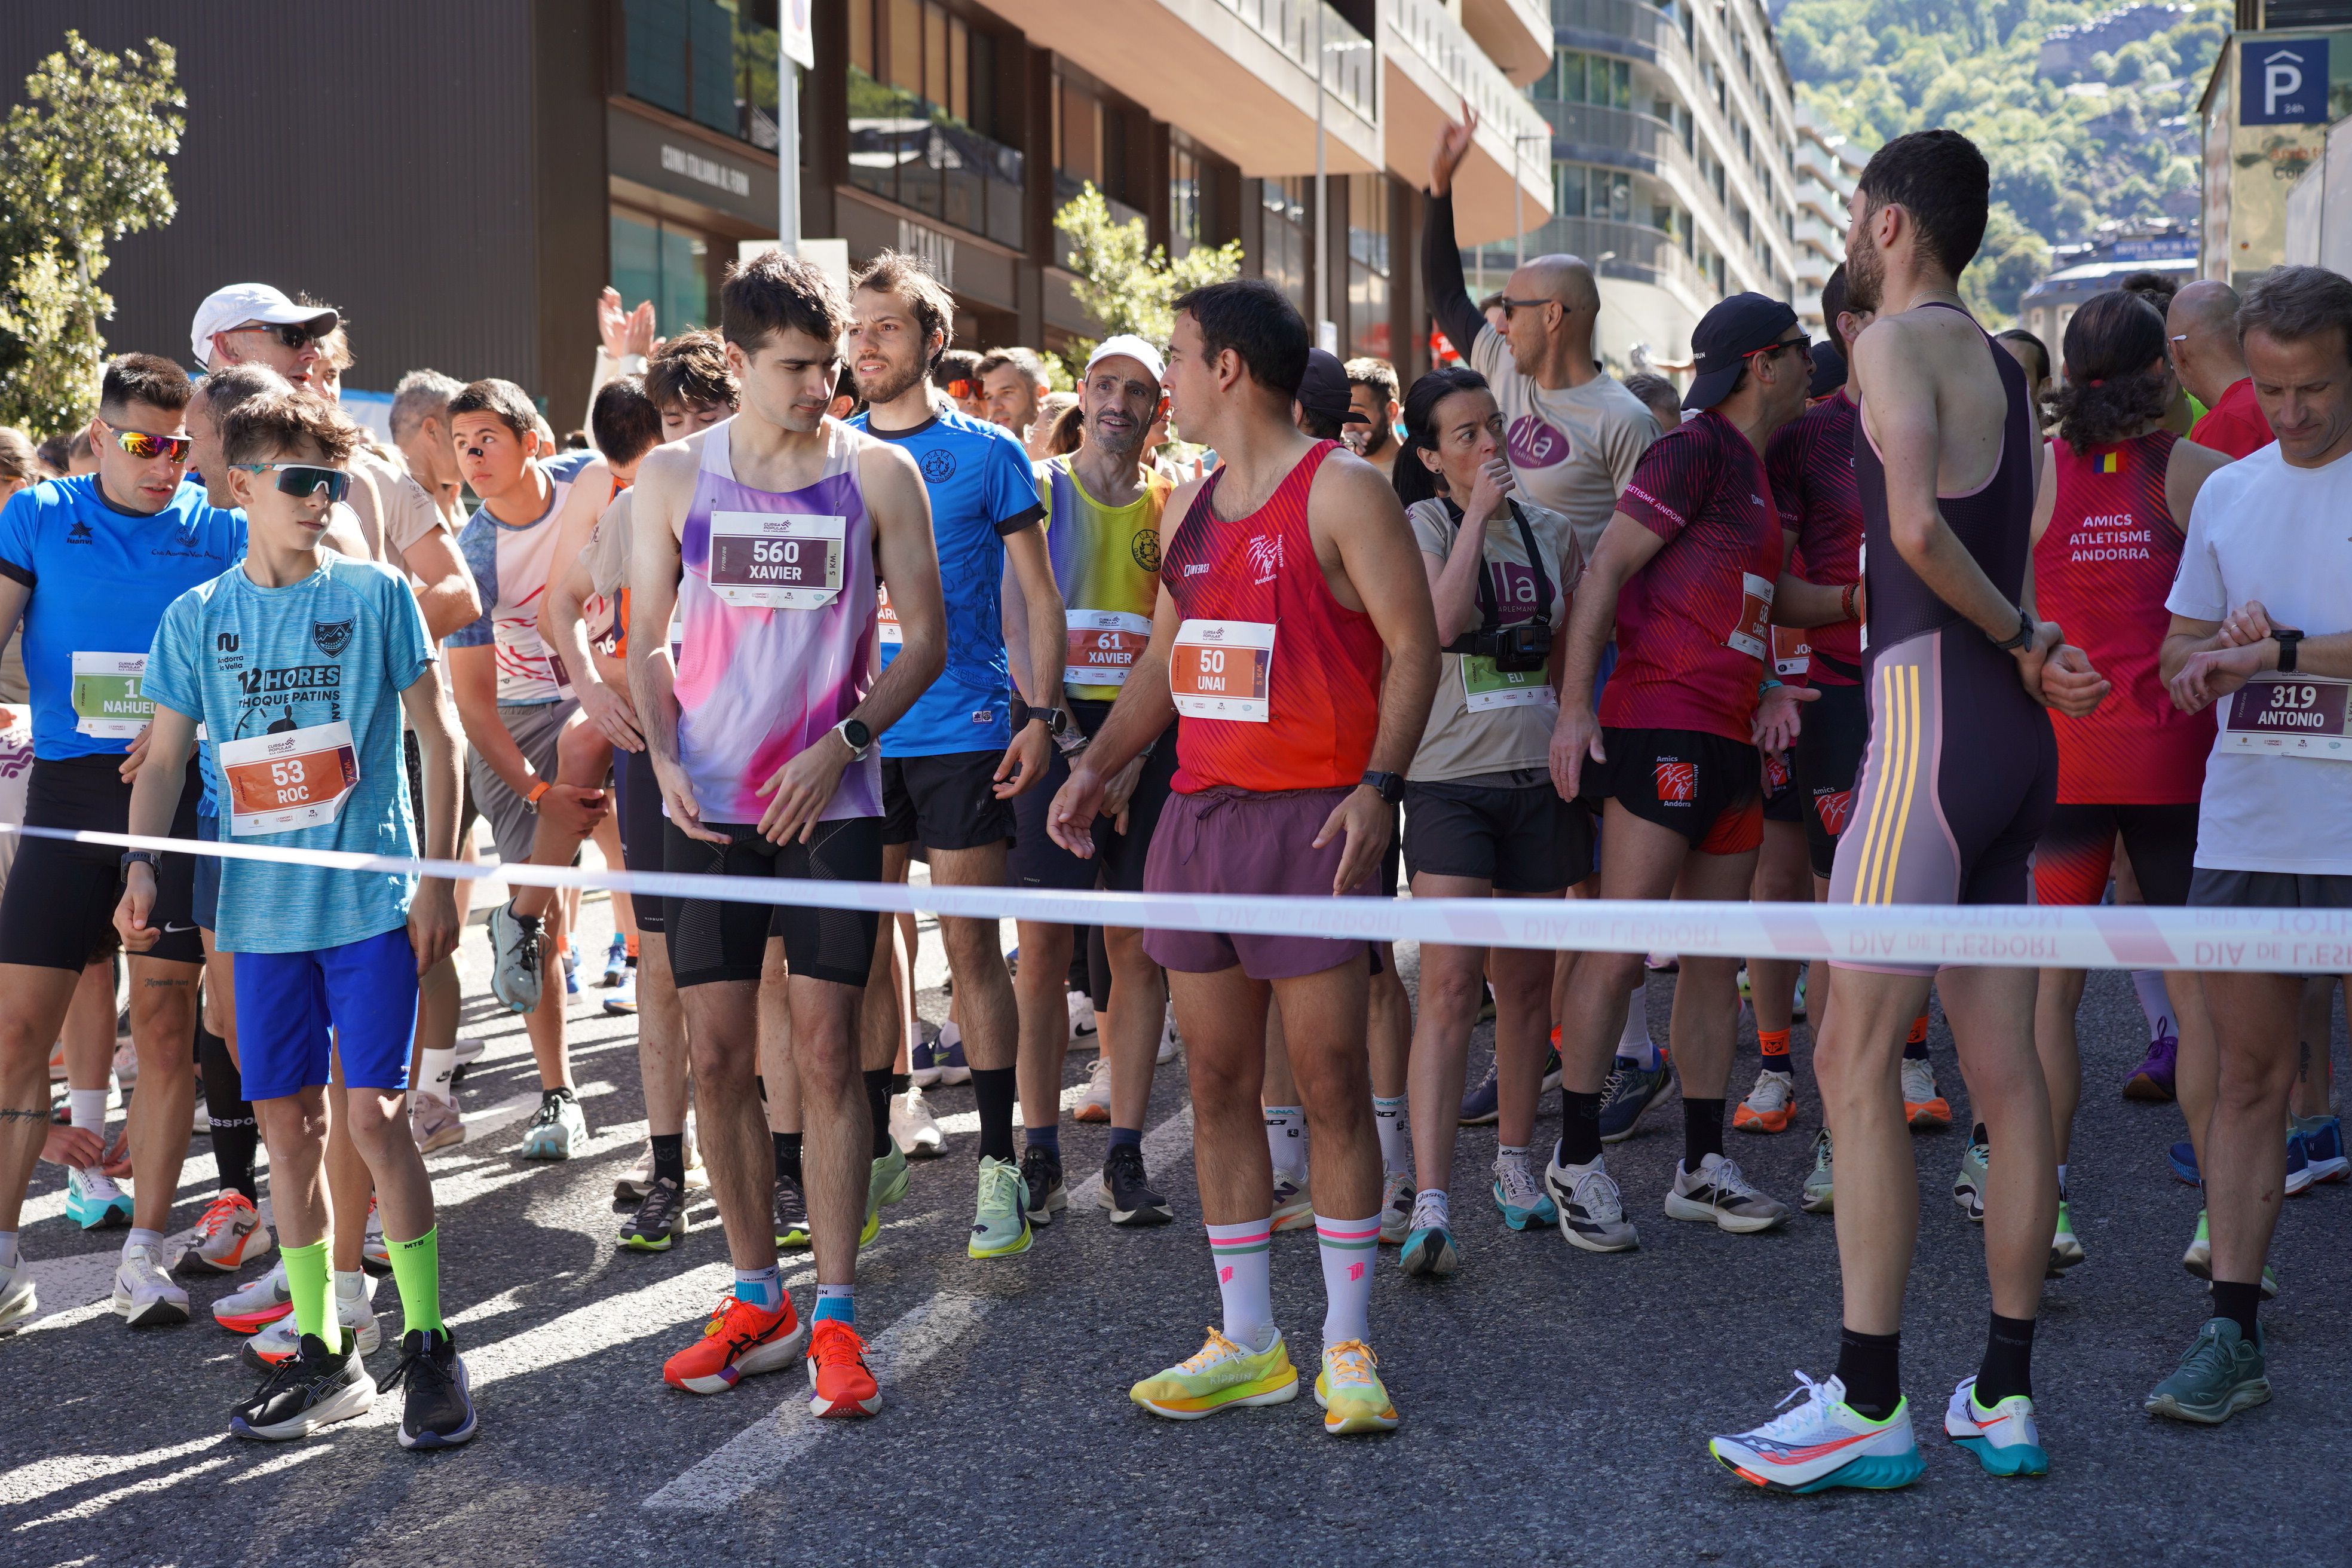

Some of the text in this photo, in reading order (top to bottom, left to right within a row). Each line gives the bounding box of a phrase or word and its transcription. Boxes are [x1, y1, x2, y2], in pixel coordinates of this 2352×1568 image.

[2265, 64, 2302, 115] P
[1693, 351, 1705, 360] PRUN
[2083, 513, 2132, 528] AMICS
[1250, 534, 1266, 544] Amics
[2069, 530, 2151, 545] ATLETISME
[753, 540, 800, 564] 560
[2072, 547, 2149, 562] ANDORRA
[749, 565, 802, 580] XAVIER
[1255, 574, 1277, 586] Andorra
[1759, 605, 1769, 624] 68
[1098, 633, 1123, 650] 61
[218, 656, 244, 664] Andorra
[1089, 651, 1132, 664] XAVIER
[1200, 650, 1224, 673] 50
[238, 667, 339, 696] 12 HORES
[1198, 676, 1225, 691] UNAI
[1507, 672, 1524, 683] ELI
[292, 690, 340, 702] PATINS
[2271, 685, 2317, 709] 319
[103, 700, 157, 714] NAHUEL
[332, 702, 341, 722] AN
[2257, 710, 2325, 727] ANTONIO
[271, 760, 305, 786] 53
[344, 760, 354, 774] KM.
[277, 786, 310, 804] ROC
[1813, 786, 1835, 795] Amics
[1592, 1187, 1604, 1206] ADIZERO
[405, 1239, 424, 1249] MTB
[1209, 1372, 1252, 1385] KIPRUN
